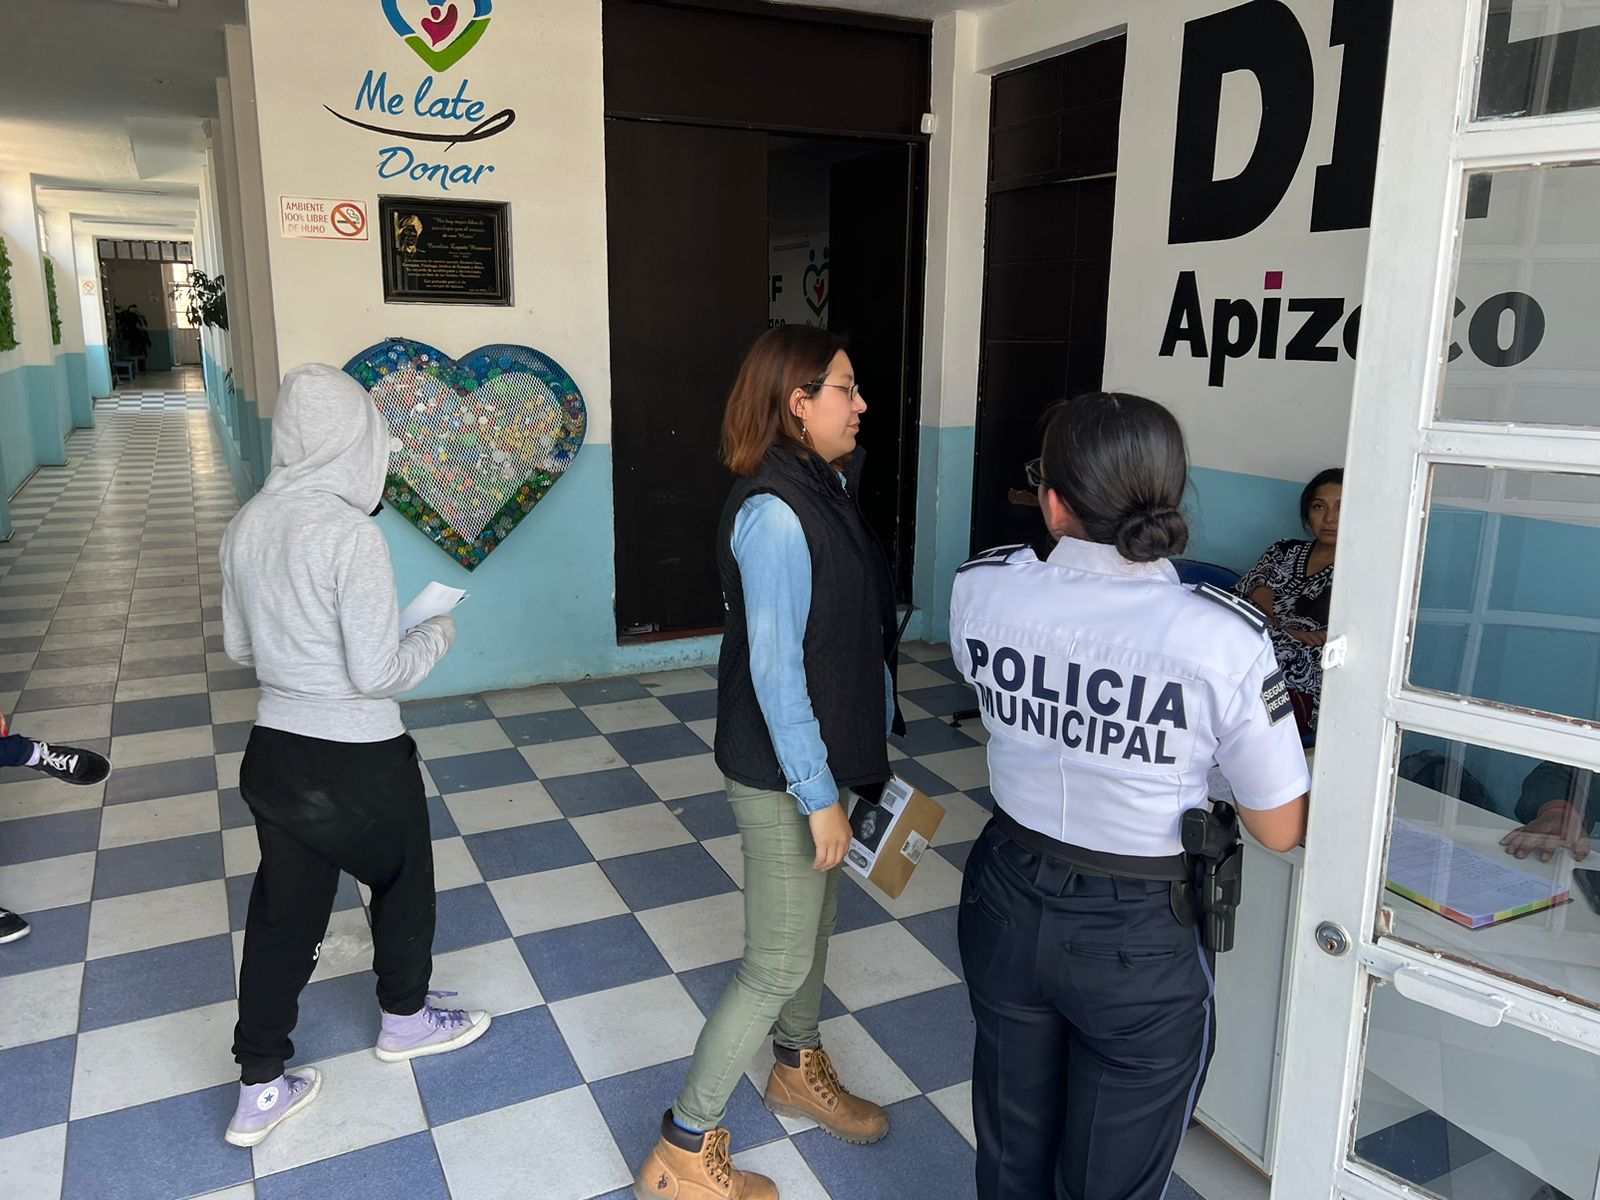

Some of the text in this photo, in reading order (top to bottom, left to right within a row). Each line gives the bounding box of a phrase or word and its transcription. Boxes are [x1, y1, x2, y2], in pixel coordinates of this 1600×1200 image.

[354, 69, 486, 123] Me late
[376, 146, 495, 191] Donar
[285, 212, 328, 223] 100% LIBRE
[286, 202, 324, 212] AMBIENTE
[288, 223, 325, 233] DE HUMO
[1158, 270, 1546, 388] Apizo
[965, 638, 1189, 730] POLICIA
[974, 681, 1177, 765] MUNICIPAL
